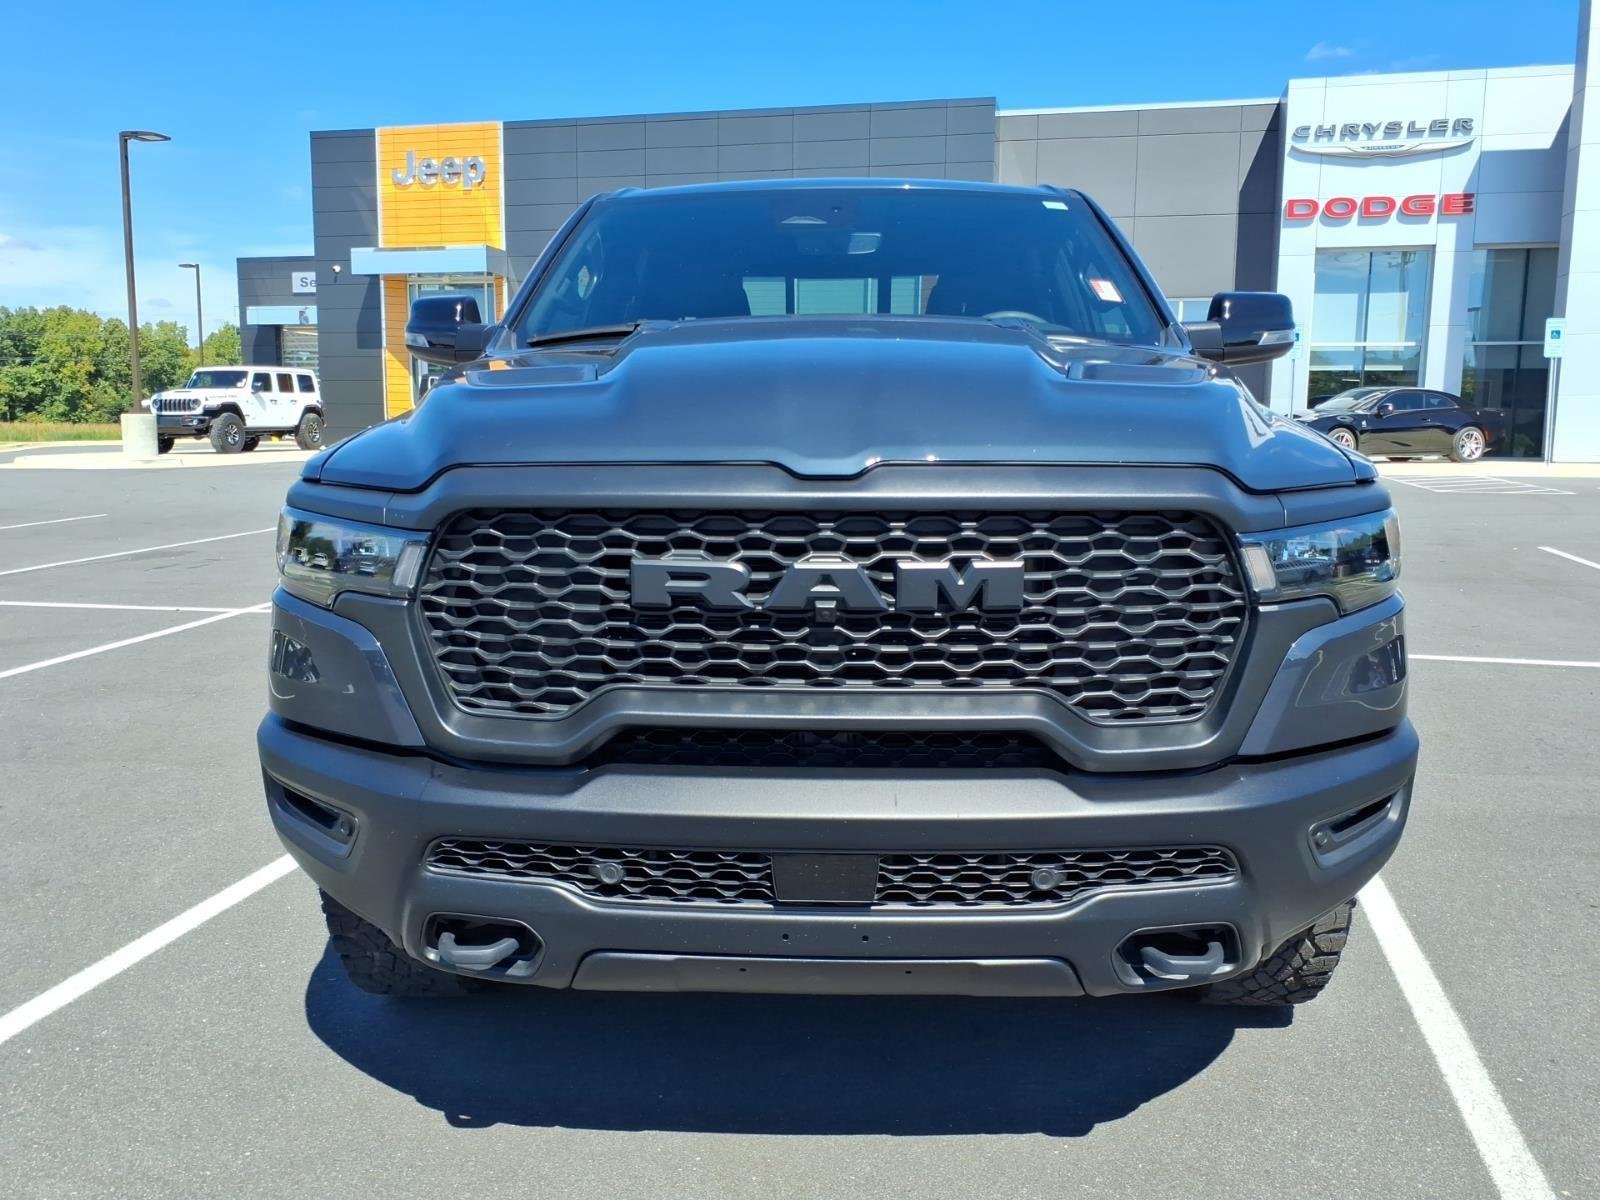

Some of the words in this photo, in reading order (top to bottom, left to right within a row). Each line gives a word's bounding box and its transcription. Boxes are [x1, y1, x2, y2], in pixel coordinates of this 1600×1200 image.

[1293, 117, 1475, 138] CHRYSLER
[391, 149, 486, 190] Jeep
[1285, 192, 1476, 221] DODGE
[630, 557, 1025, 612] RAM
